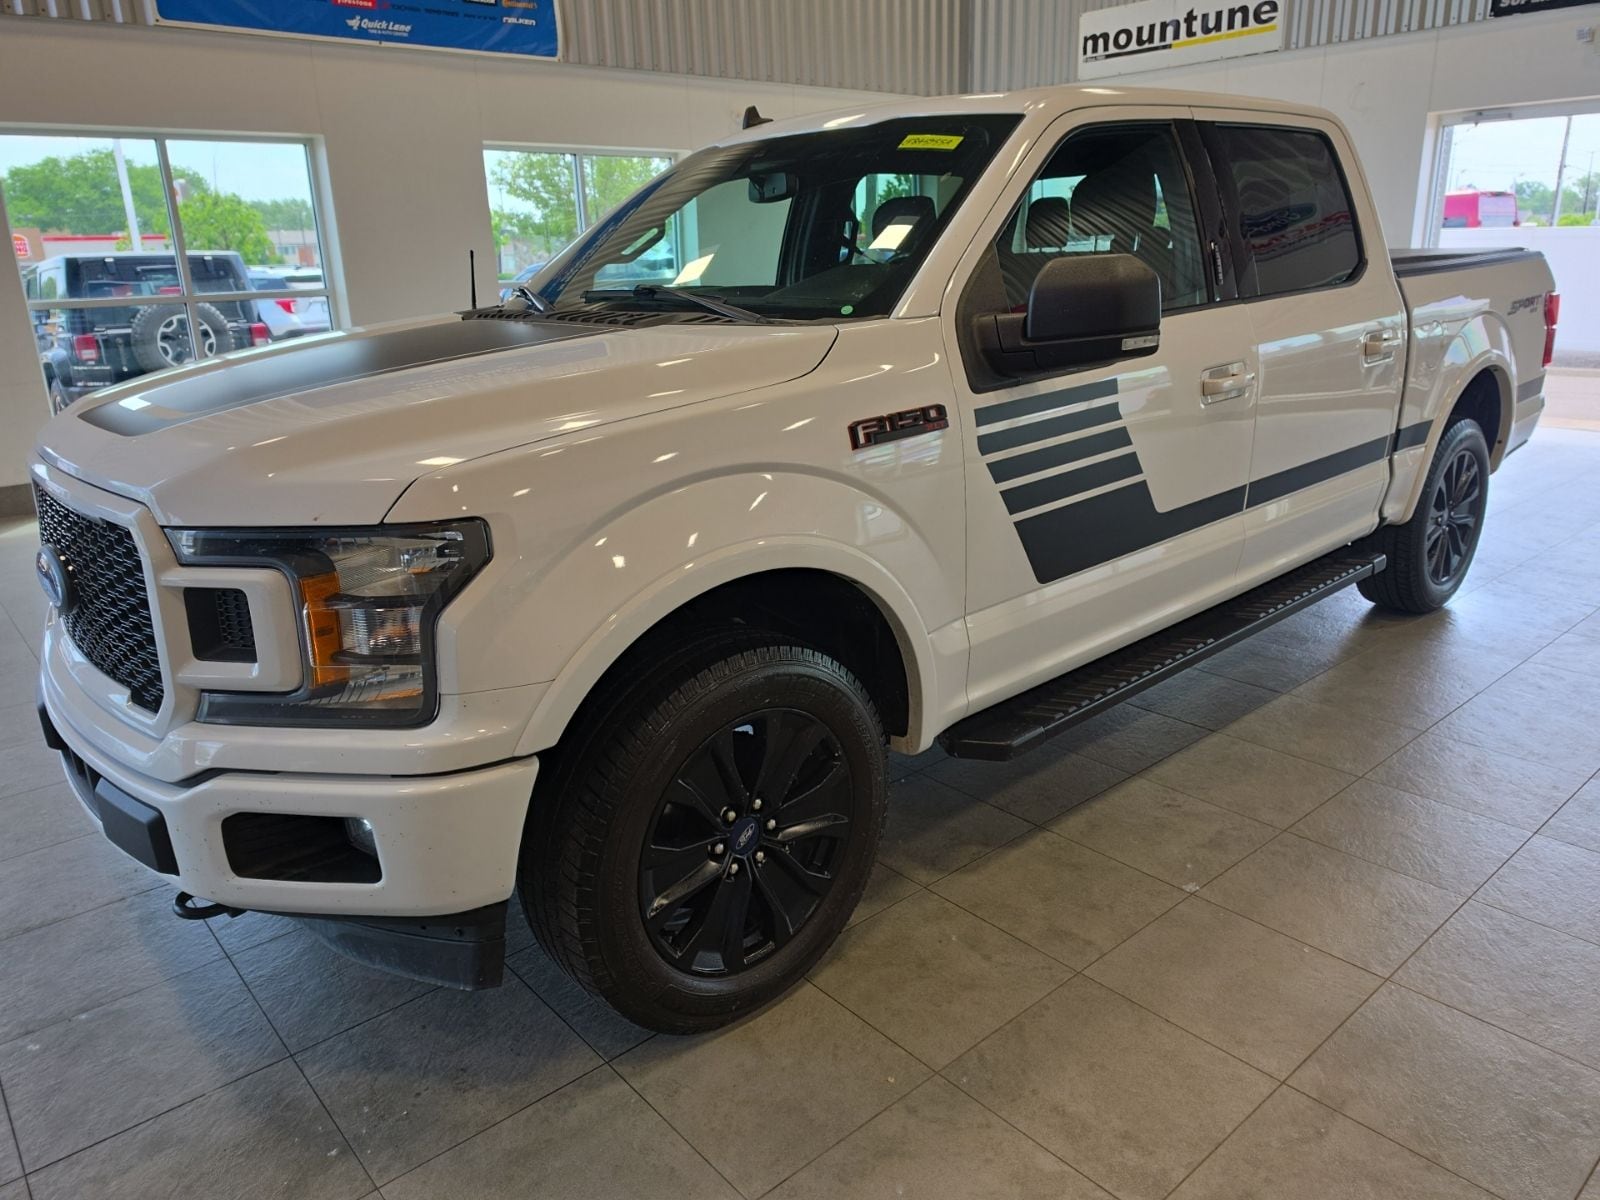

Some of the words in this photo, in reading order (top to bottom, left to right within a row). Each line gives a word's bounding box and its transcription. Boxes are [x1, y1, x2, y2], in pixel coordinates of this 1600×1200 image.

[361, 18, 387, 30] Quick
[388, 21, 412, 33] Lane
[1083, 0, 1279, 56] mountune
[1507, 294, 1542, 316] SPORT
